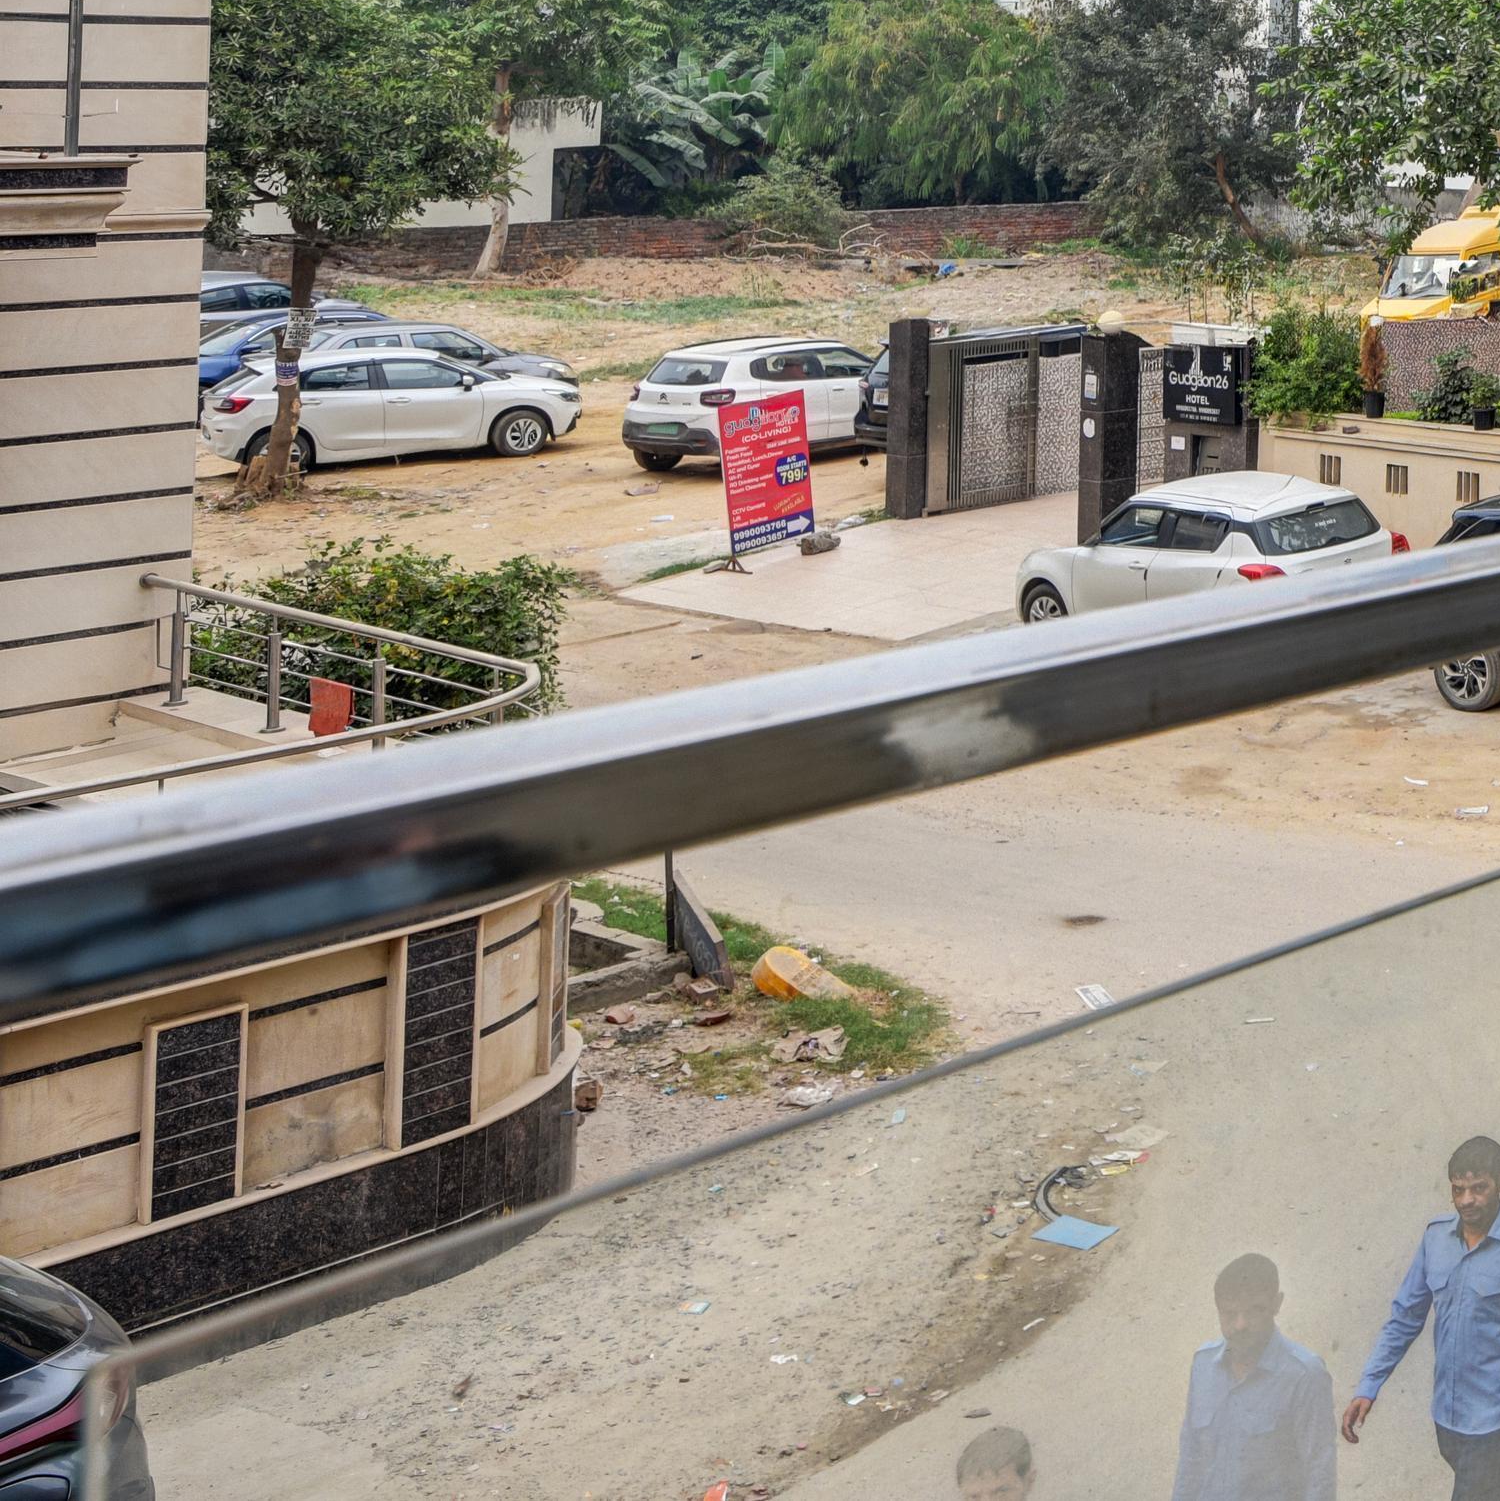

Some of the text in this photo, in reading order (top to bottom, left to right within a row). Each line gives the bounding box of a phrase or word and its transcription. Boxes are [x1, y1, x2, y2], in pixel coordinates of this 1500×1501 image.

[1186, 394, 1210, 405] HOTEL
[741, 426, 792, 444] (CO-LIVING)
[780, 467, 808, 485] 799/-
[732, 507, 746, 515] CCTV
